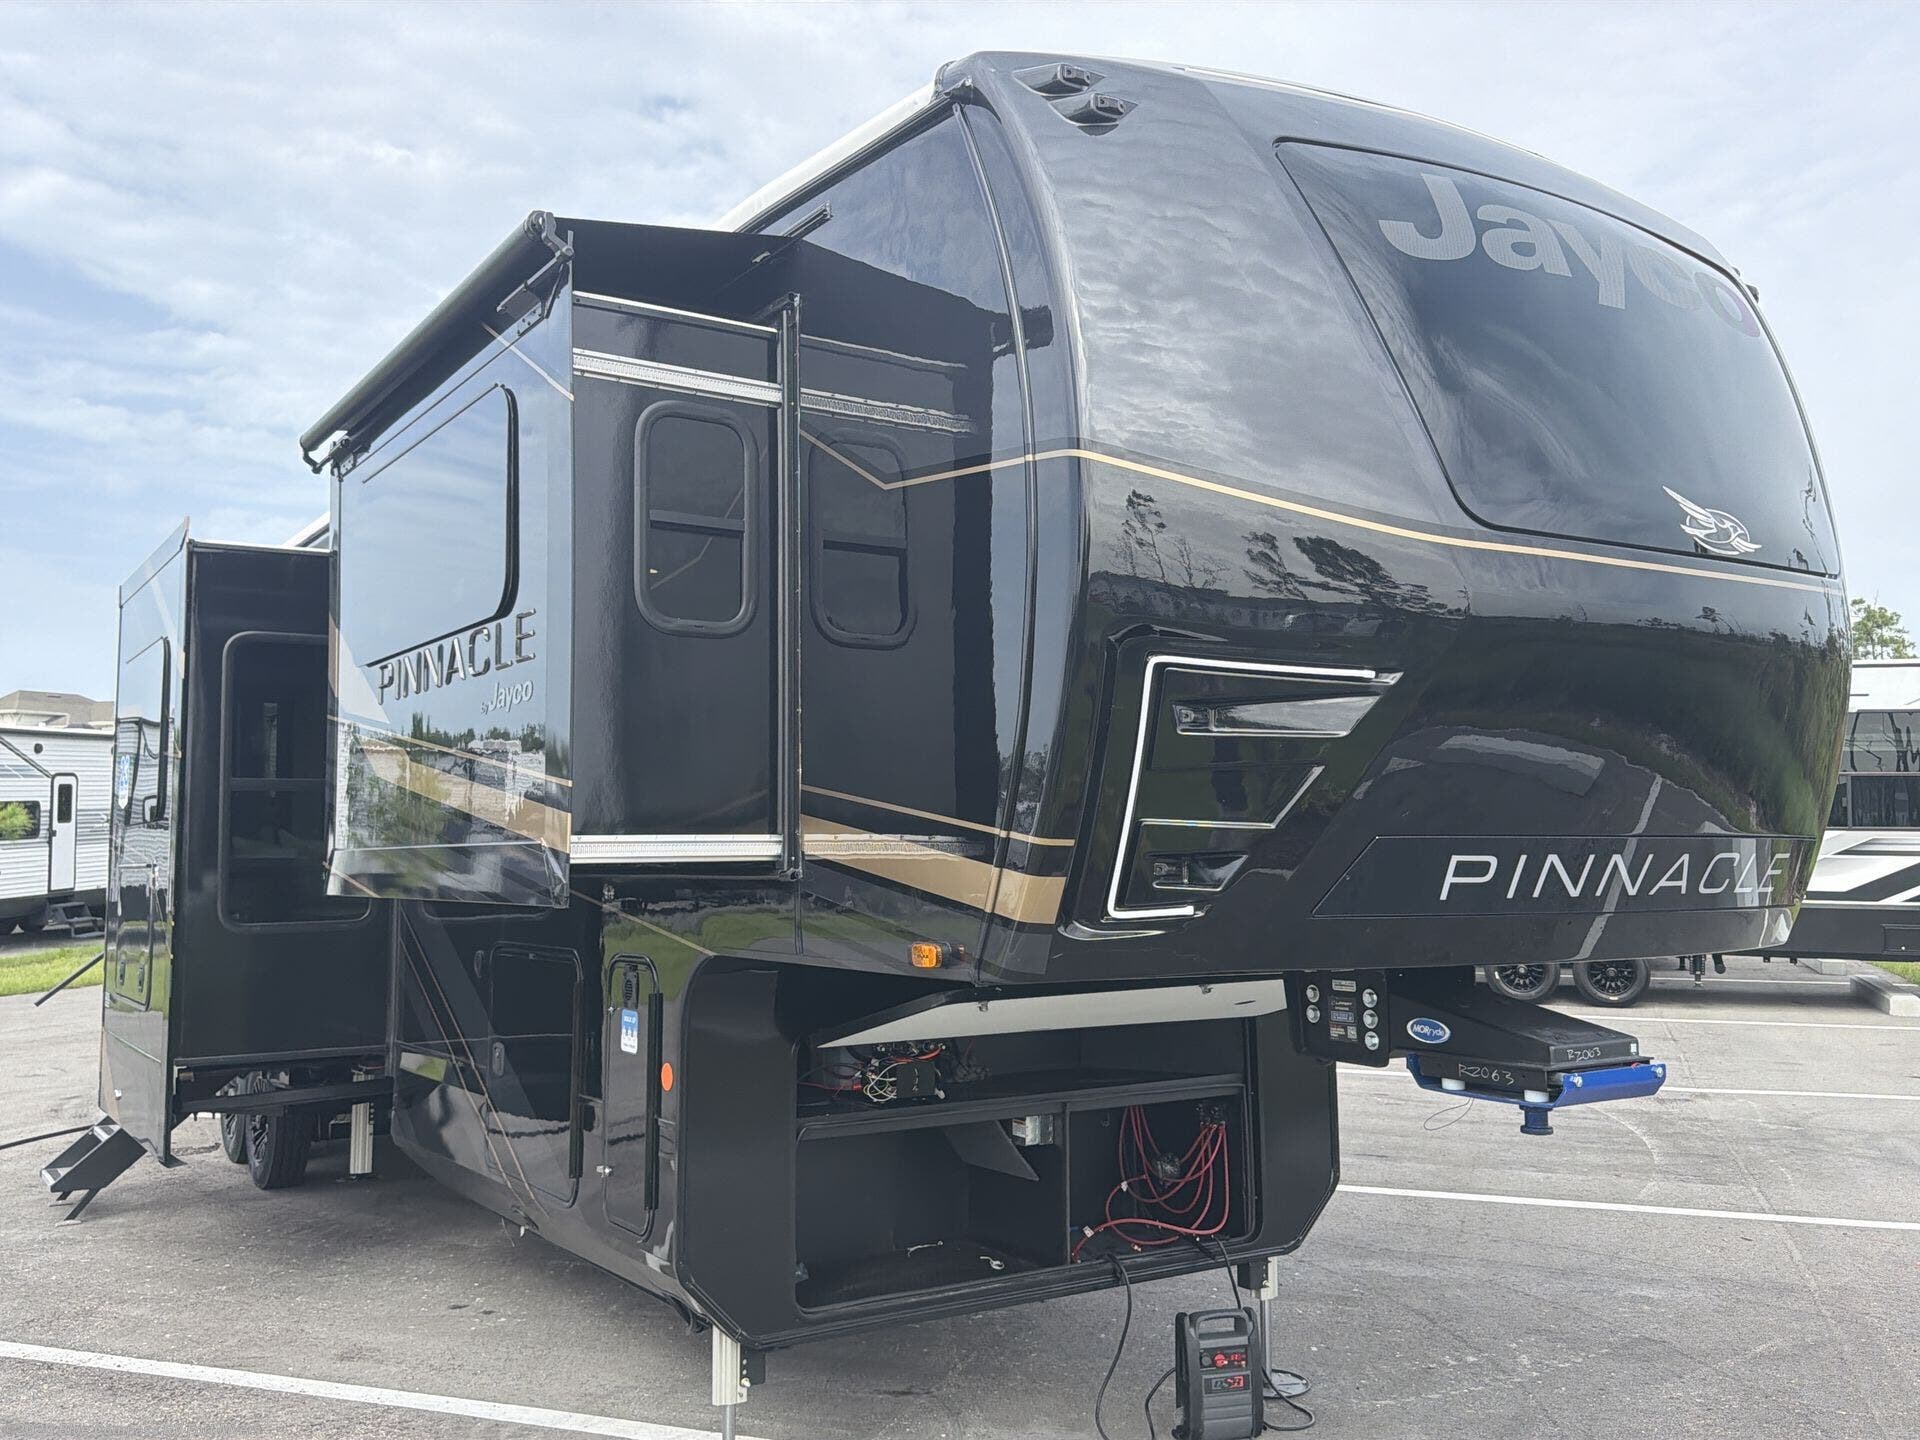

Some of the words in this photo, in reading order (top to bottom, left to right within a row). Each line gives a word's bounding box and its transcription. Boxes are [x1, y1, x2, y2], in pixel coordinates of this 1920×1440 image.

[1378, 174, 1762, 338] Jayco
[377, 607, 537, 706] PINNACLE
[488, 680, 534, 713] Jayco
[1438, 852, 1791, 901] PINNACLE
